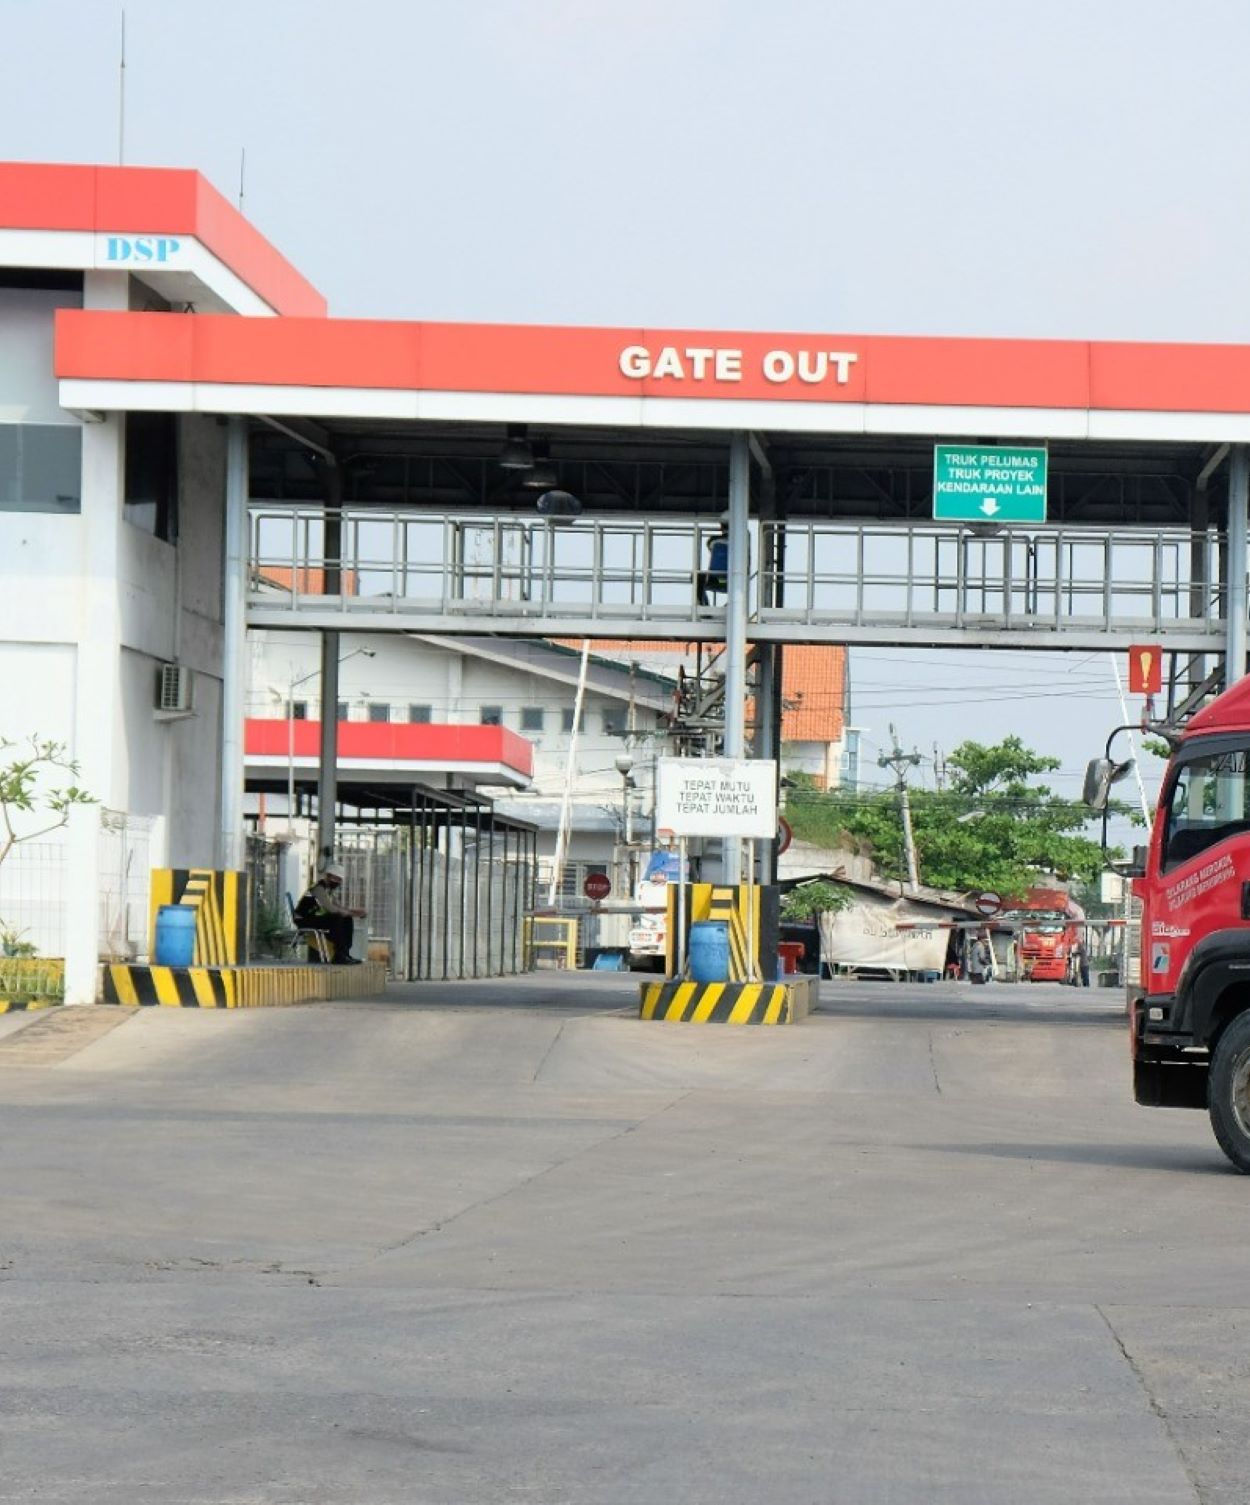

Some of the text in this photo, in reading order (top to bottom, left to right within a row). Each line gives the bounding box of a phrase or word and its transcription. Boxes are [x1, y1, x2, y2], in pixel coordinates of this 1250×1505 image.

[106, 237, 180, 262] DSP
[619, 346, 858, 384] GATE OUT
[945, 454, 1038, 468] TRUK PELUMAS
[949, 469, 1034, 482] TRUK PROYEK
[938, 482, 1045, 495] KENDARAAN LAIN
[684, 780, 751, 792] TEPAT MUTU
[680, 792, 754, 803] TEPAT WAKTU
[677, 802, 758, 815] TEPAT JUMLAH
